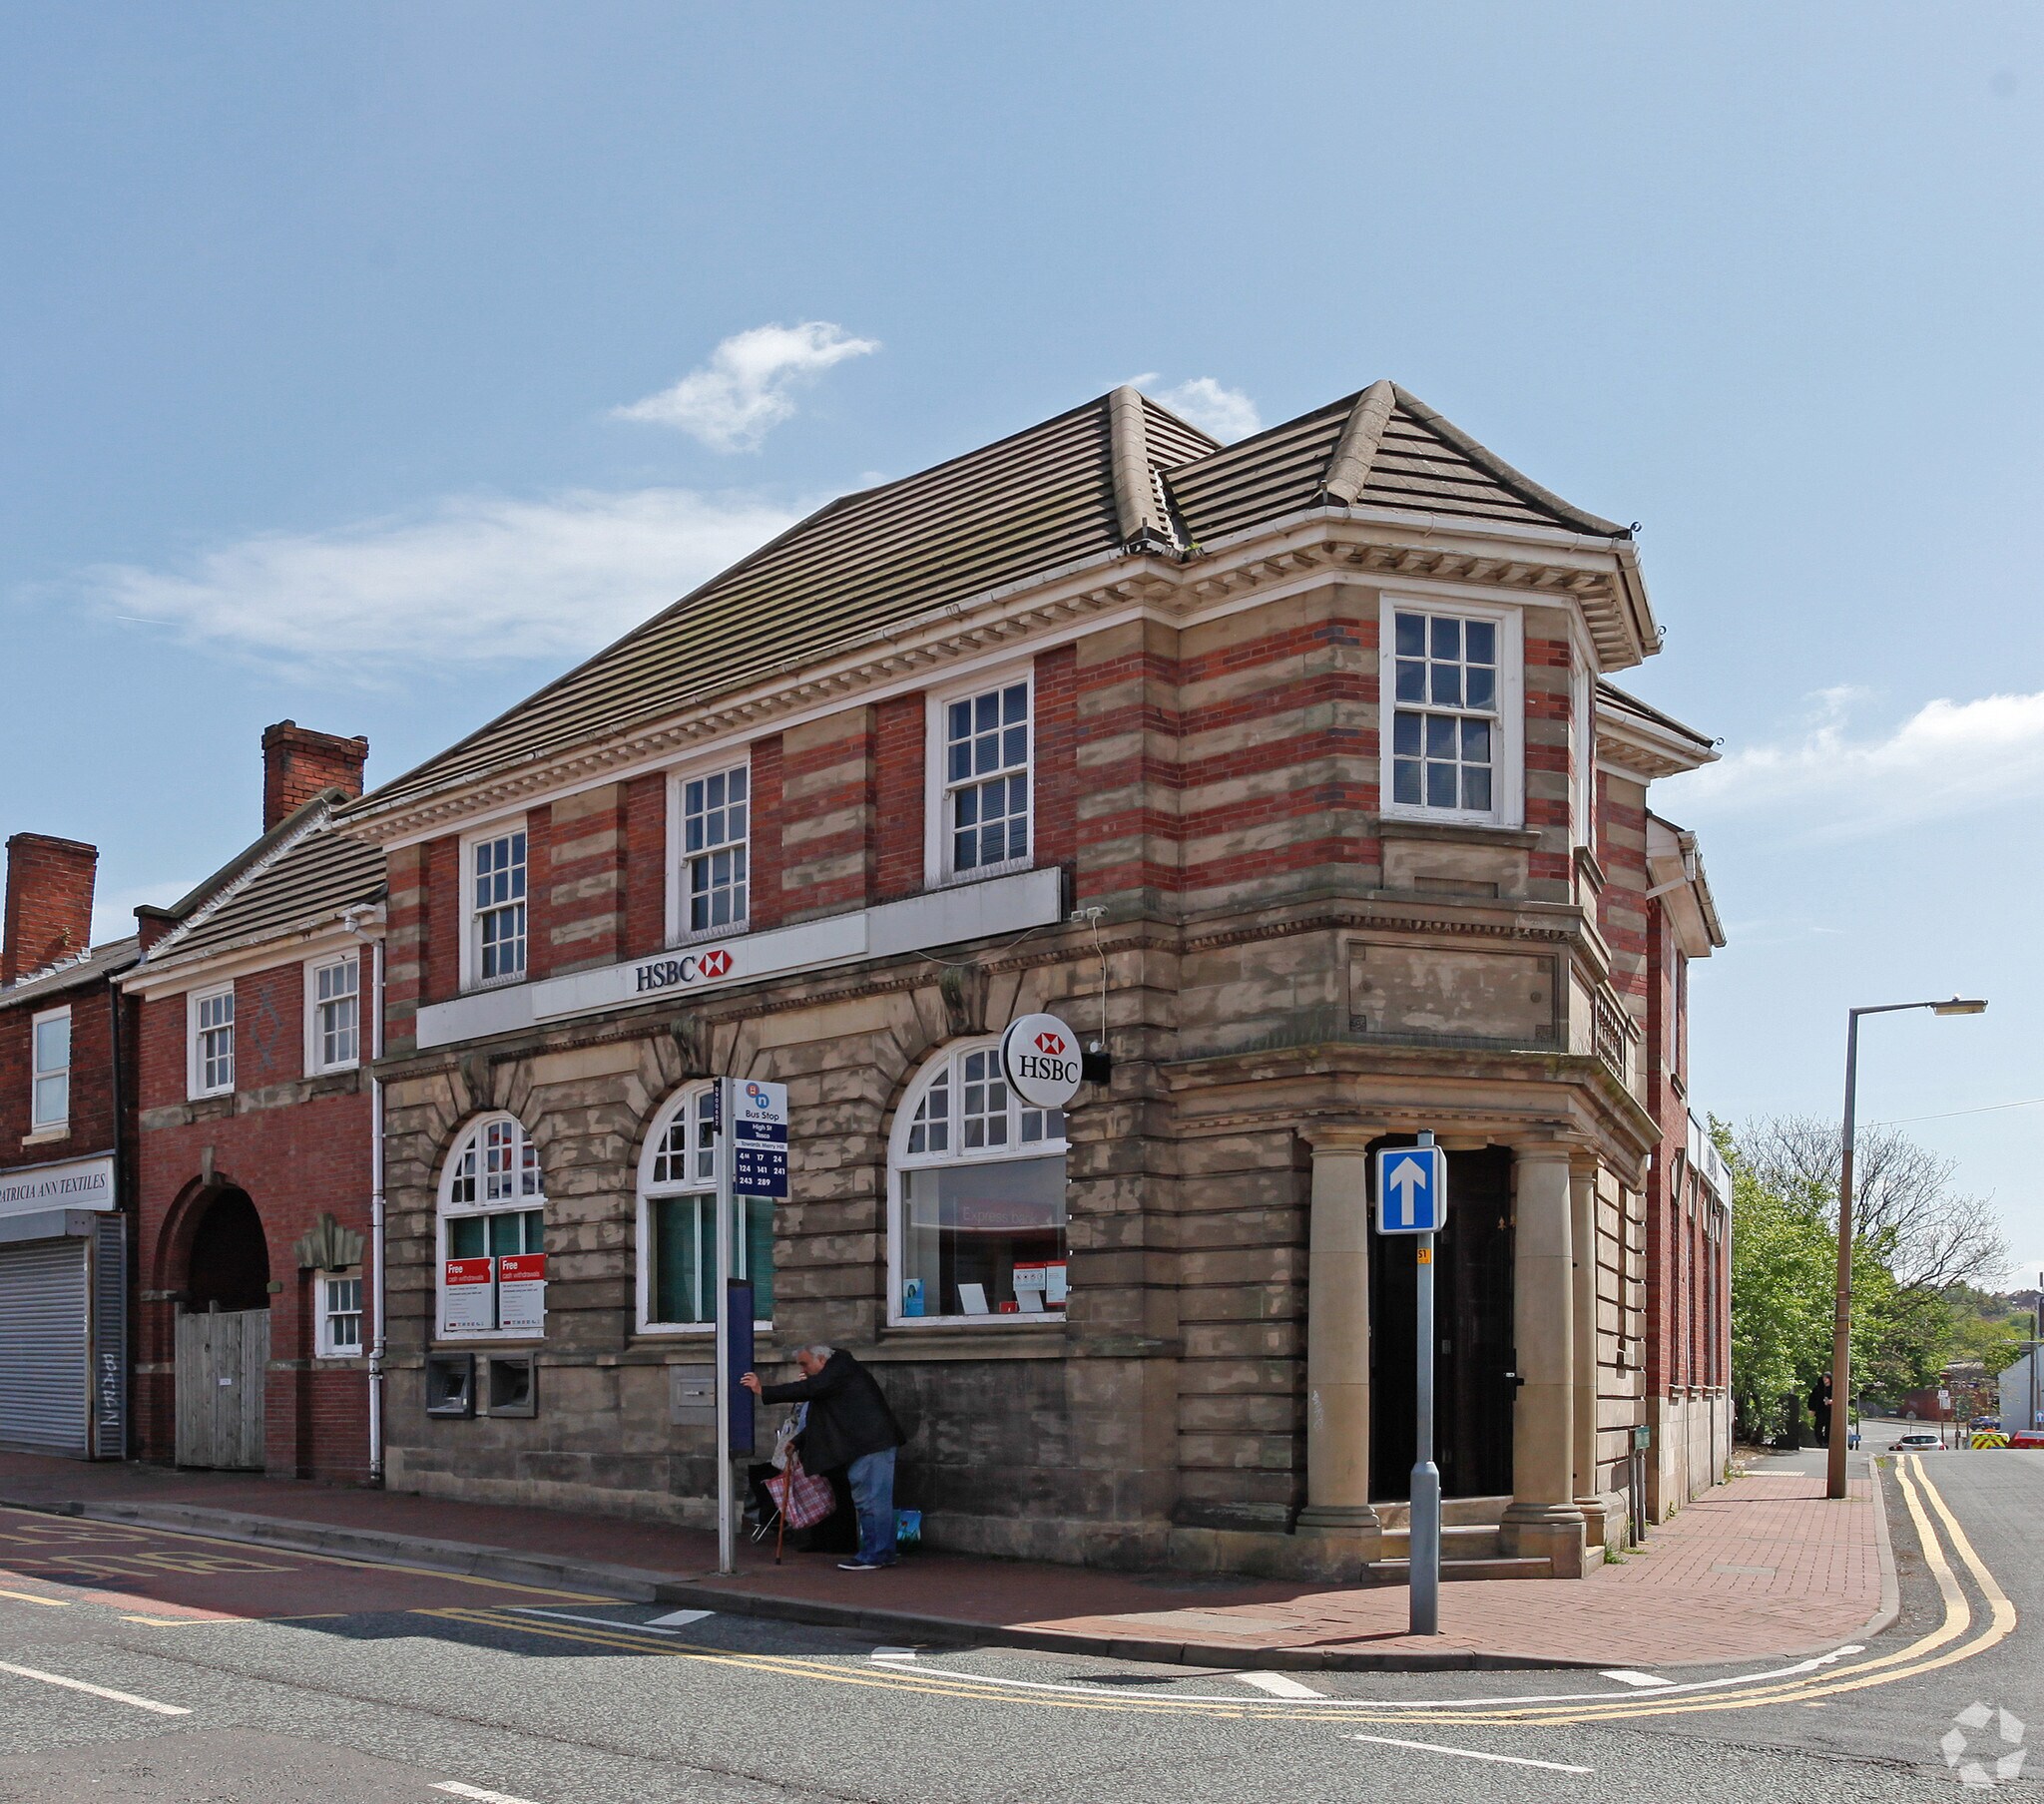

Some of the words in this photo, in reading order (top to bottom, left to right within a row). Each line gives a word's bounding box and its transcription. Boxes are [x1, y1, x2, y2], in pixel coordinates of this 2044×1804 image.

[636, 956, 697, 992] HSBC
[1019, 1055, 1079, 1084] HSBC
[746, 1110, 760, 1119] Bus
[762, 1112, 779, 1122] Stop
[38, 1179, 59, 1197] ANN
[60, 1172, 106, 1194] TEXTILES
[448, 1264, 463, 1273] Free
[502, 1260, 518, 1270] Free
